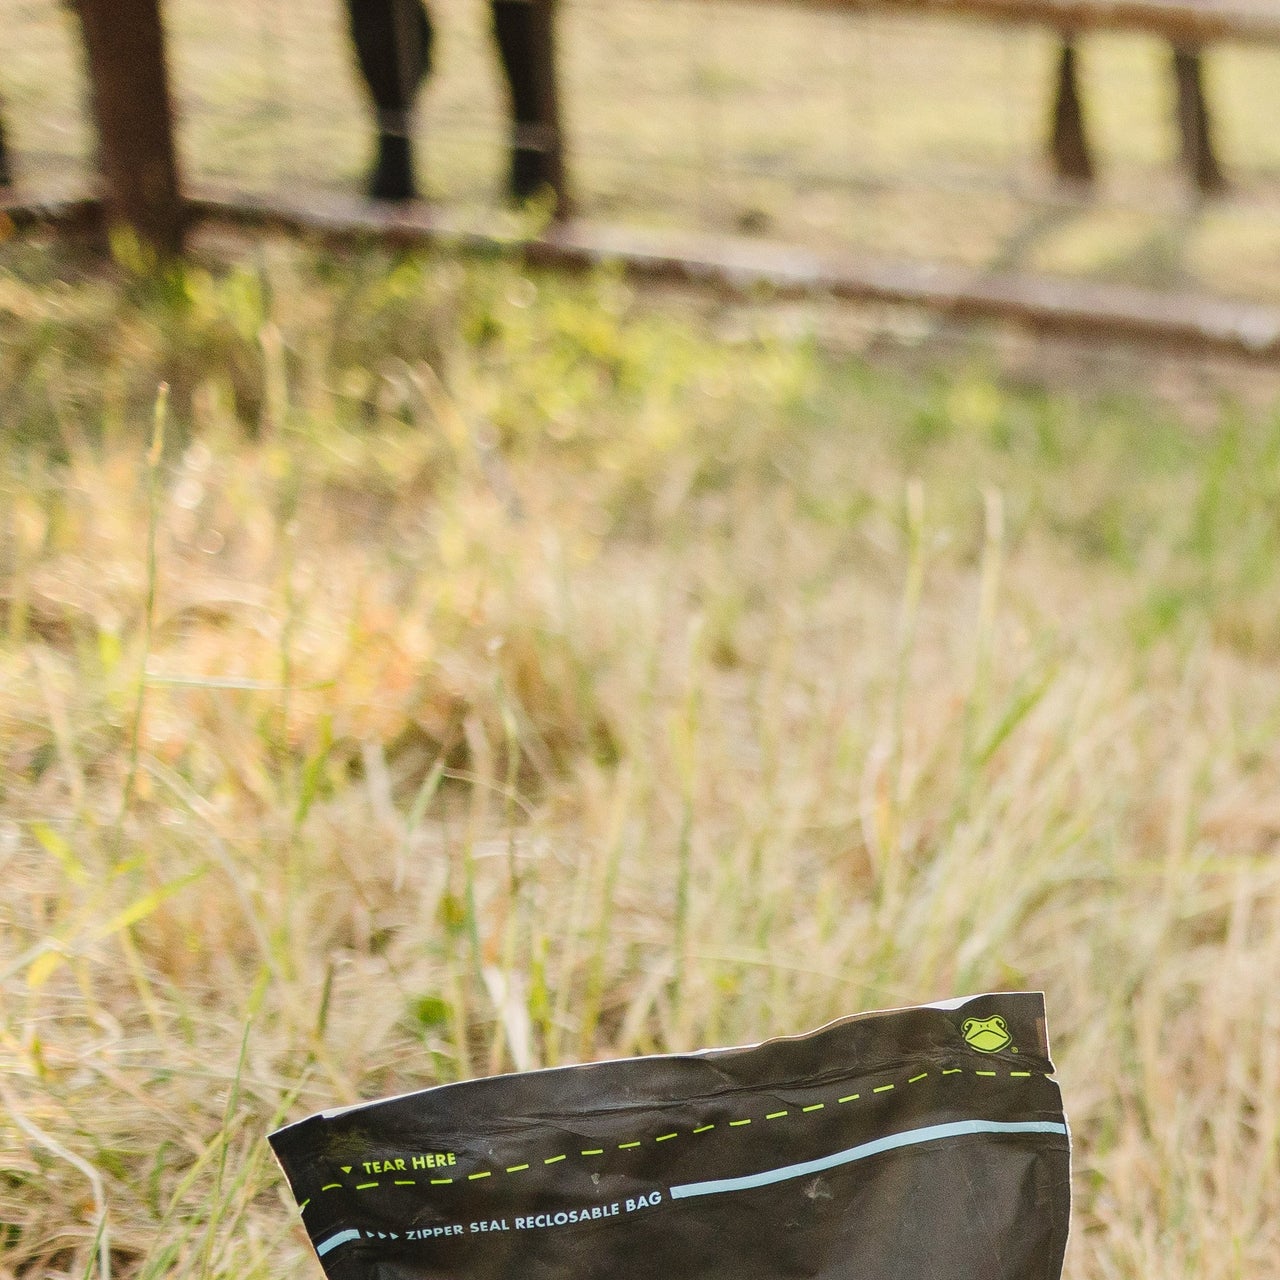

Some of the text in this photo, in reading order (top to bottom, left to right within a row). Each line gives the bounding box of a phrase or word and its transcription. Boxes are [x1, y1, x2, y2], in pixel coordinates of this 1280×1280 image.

[362, 1153, 457, 1175] TEAR HERE
[405, 1191, 662, 1241] ZIPPER SEAL RECLOSABLE BAG
